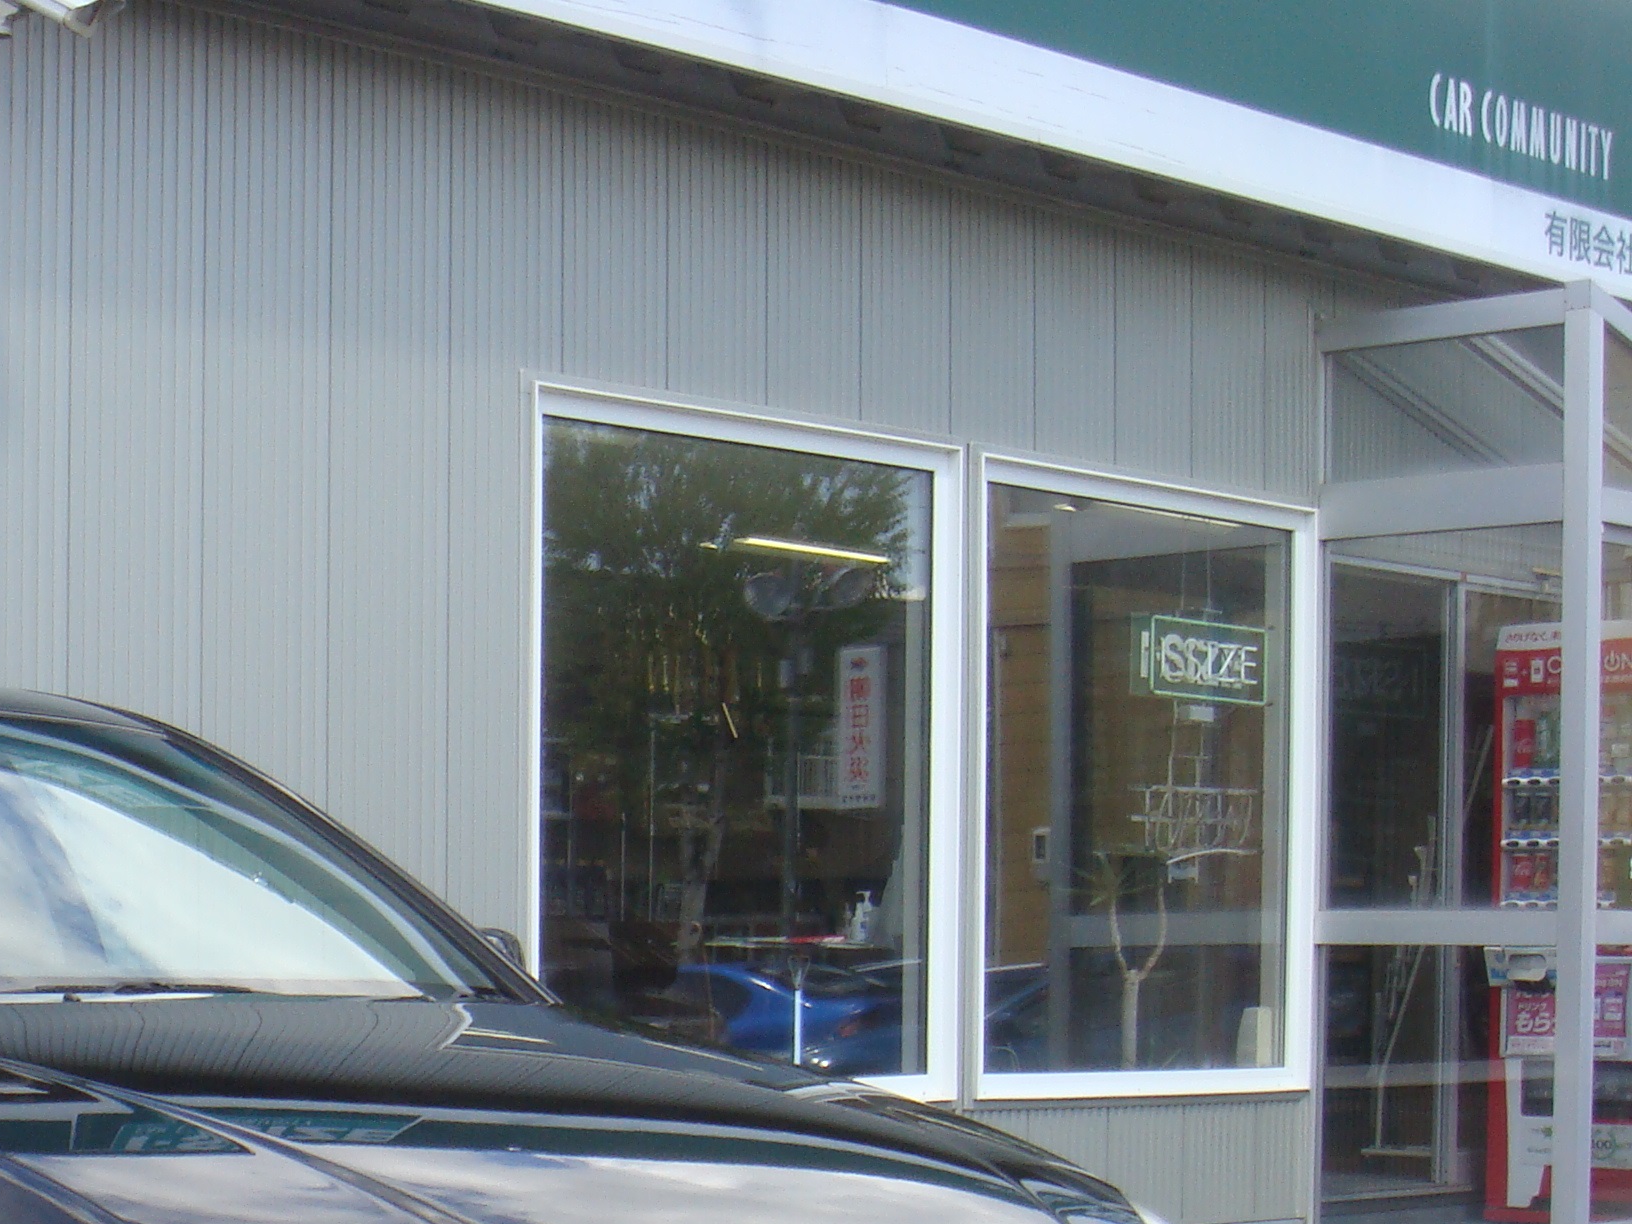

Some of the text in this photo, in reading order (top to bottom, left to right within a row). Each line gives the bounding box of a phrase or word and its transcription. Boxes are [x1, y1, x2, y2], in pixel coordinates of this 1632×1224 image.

[1429, 72, 1613, 181] CAR COMMUNITY
[1544, 210, 1632, 275] 有限会社
